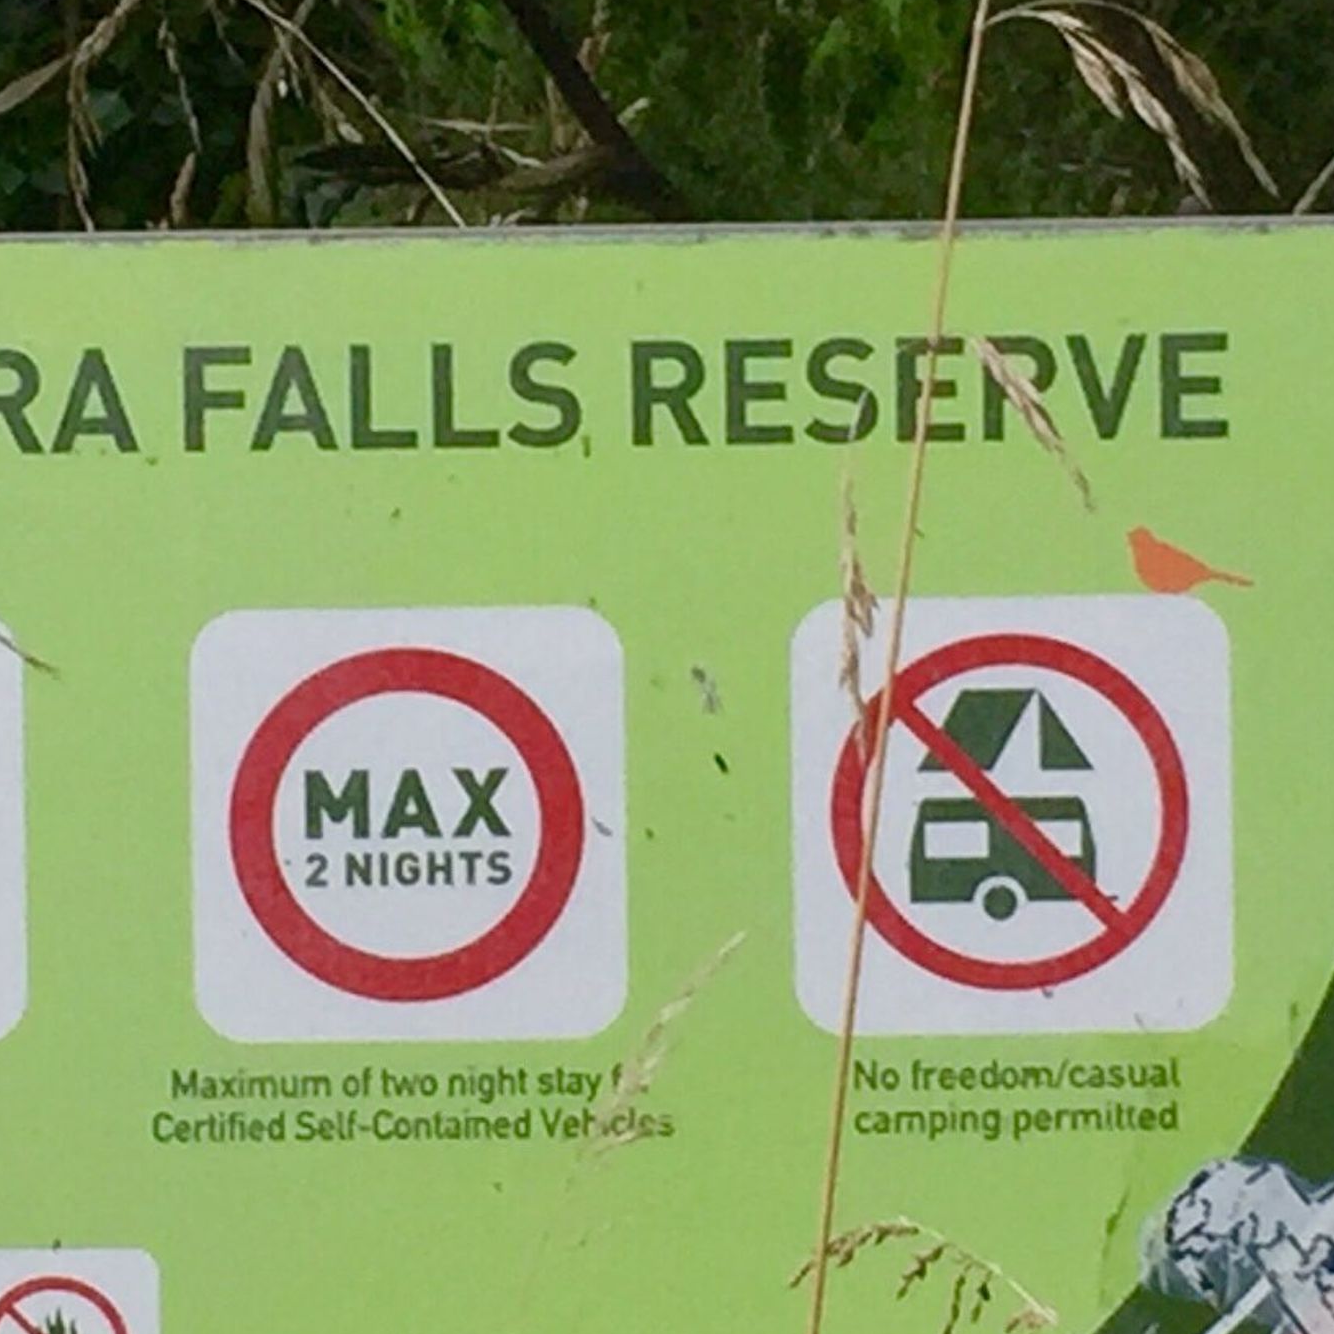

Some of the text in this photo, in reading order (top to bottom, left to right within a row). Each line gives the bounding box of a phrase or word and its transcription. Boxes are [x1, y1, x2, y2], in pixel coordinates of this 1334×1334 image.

[181, 340, 584, 453] FALLS
[629, 332, 1229, 447] RESERVE
[305, 767, 512, 840] MAX
[305, 851, 513, 887] 2 NIGHTS
[172, 1068, 331, 1099] Maximum
[342, 1066, 372, 1098] of
[381, 1070, 438, 1098] two
[448, 1066, 527, 1104] night
[537, 1067, 603, 1103] stay
[853, 1056, 1182, 1091] No freedom/casual
[152, 1110, 285, 1143] Certified
[294, 1108, 531, 1142] Self-Contained
[854, 1101, 1179, 1142] camping permitted
